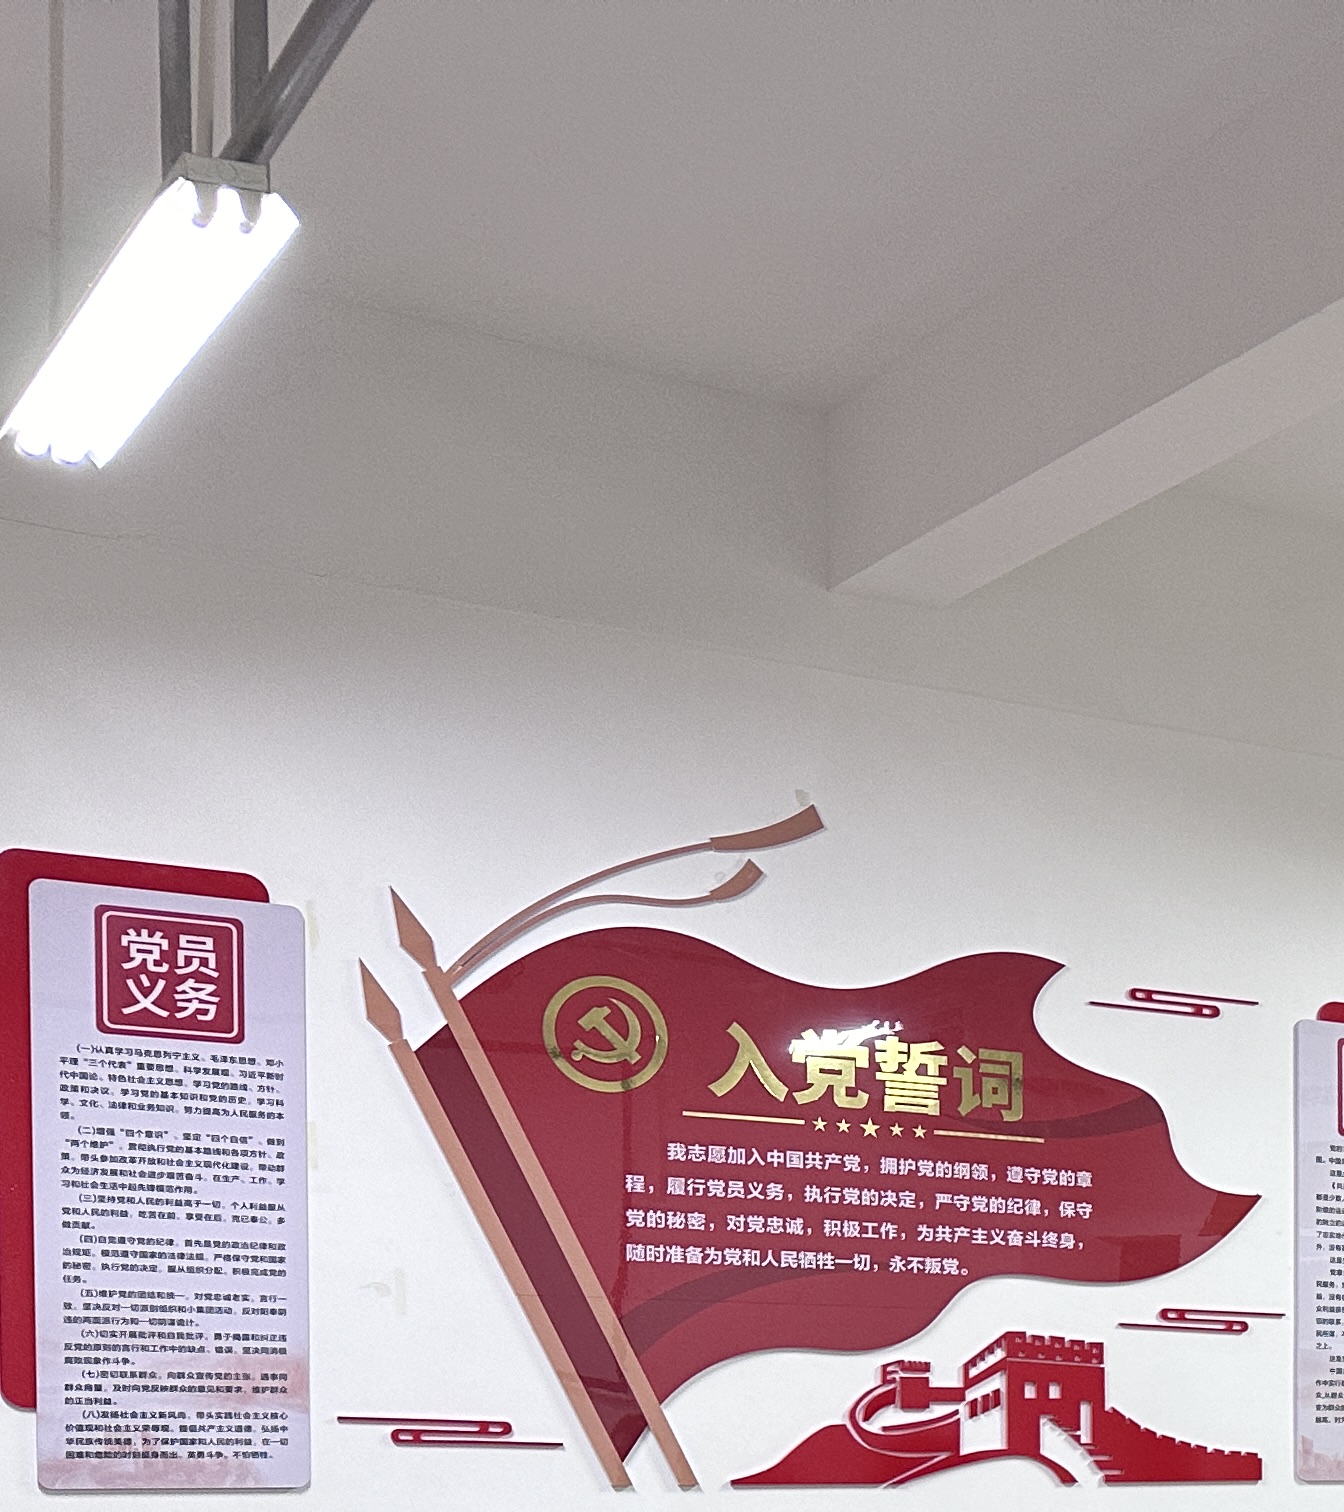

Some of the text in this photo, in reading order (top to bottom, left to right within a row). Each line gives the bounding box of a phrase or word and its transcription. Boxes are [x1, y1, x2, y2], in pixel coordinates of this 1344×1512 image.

[120, 928, 220, 978] 党员
[120, 973, 221, 1021] 义务
[707, 1022, 1025, 1122] 入党誓词
[666, 1142, 1093, 1189] 我志愿加入中国共产党，拥护党的纲领，遵守党的章
[625, 1174, 1093, 1220] 程，履行党员义务，执行党的决定，严守党的纪律，保守
[625, 1209, 1087, 1250] 党的秘密，对党忠诚，积极工作，为共产主义奋斗终身，
[625, 1243, 970, 1277] 随时准备为党和人民牺牲一切，永不叛党。
